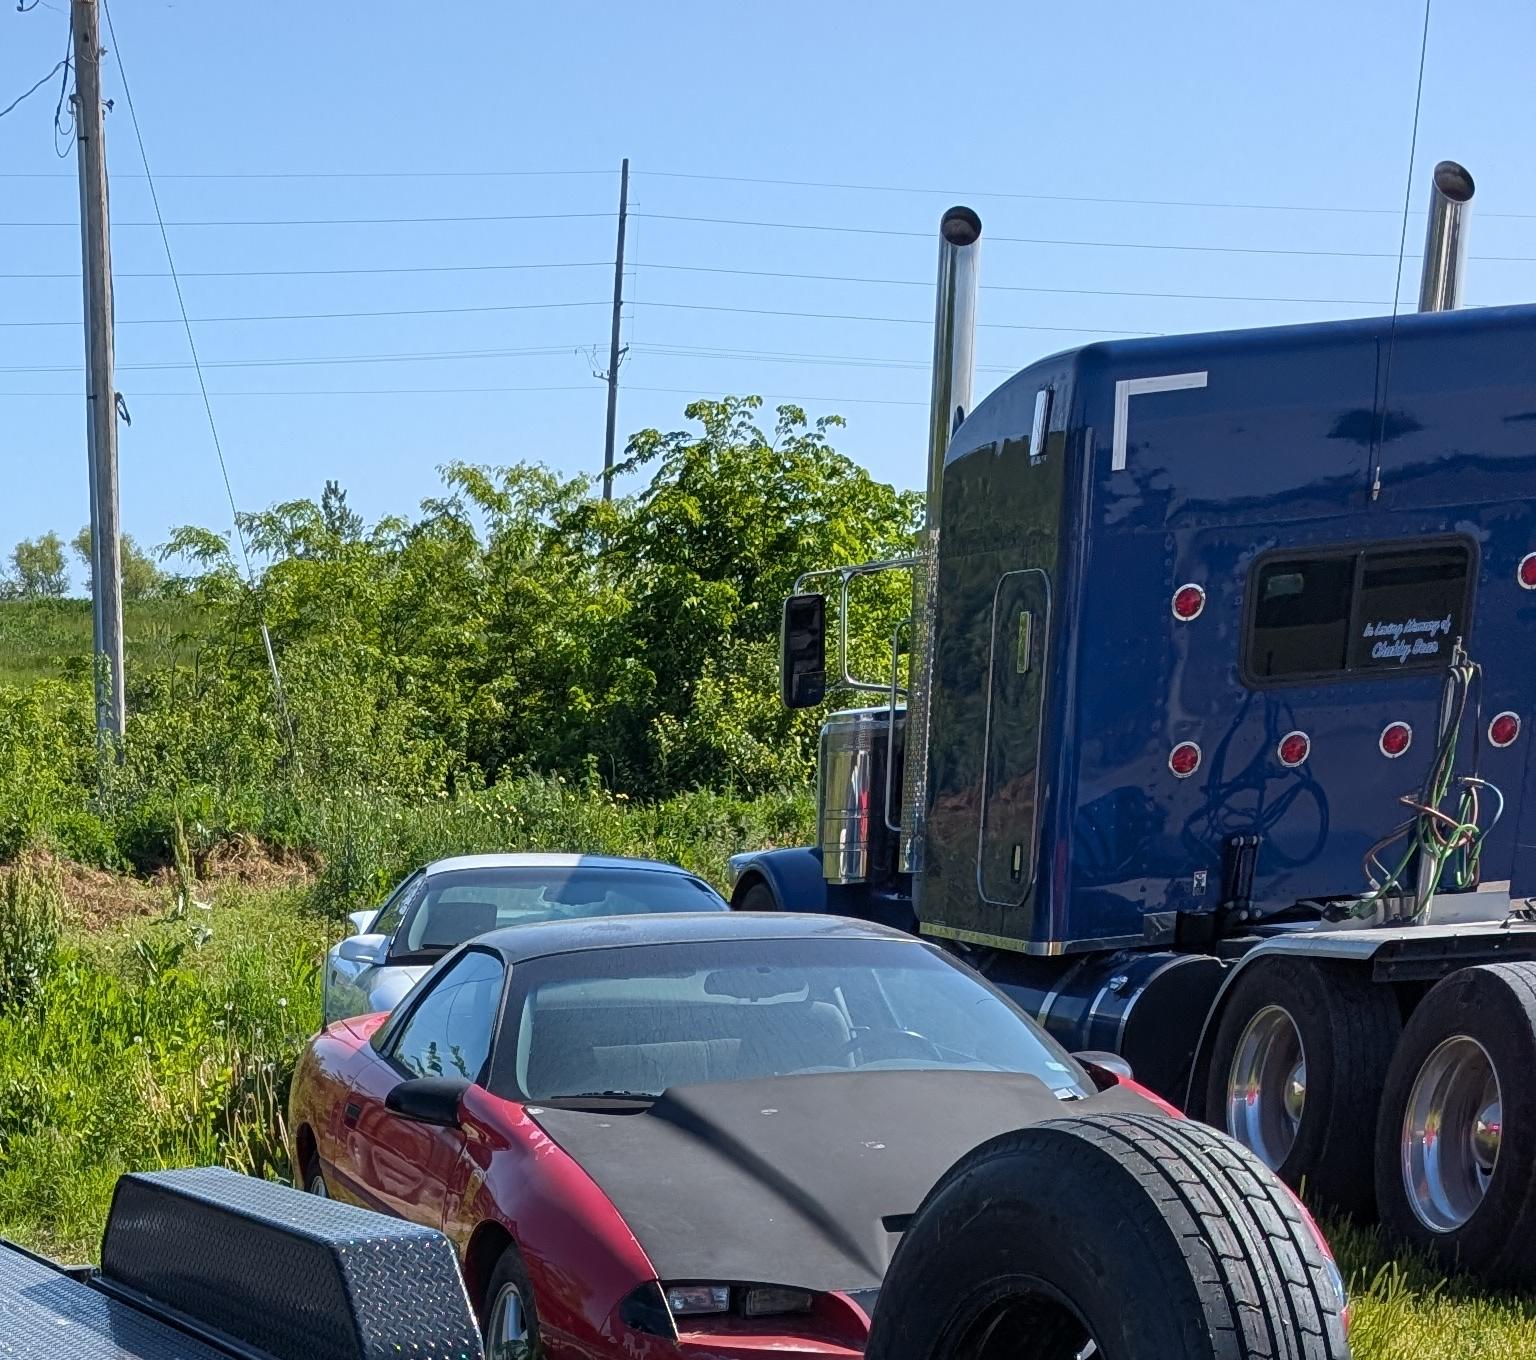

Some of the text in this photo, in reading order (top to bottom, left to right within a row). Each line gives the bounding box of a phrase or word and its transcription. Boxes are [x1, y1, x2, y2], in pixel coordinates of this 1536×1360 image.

[1363, 613, 1452, 641] In Loving Memory of
